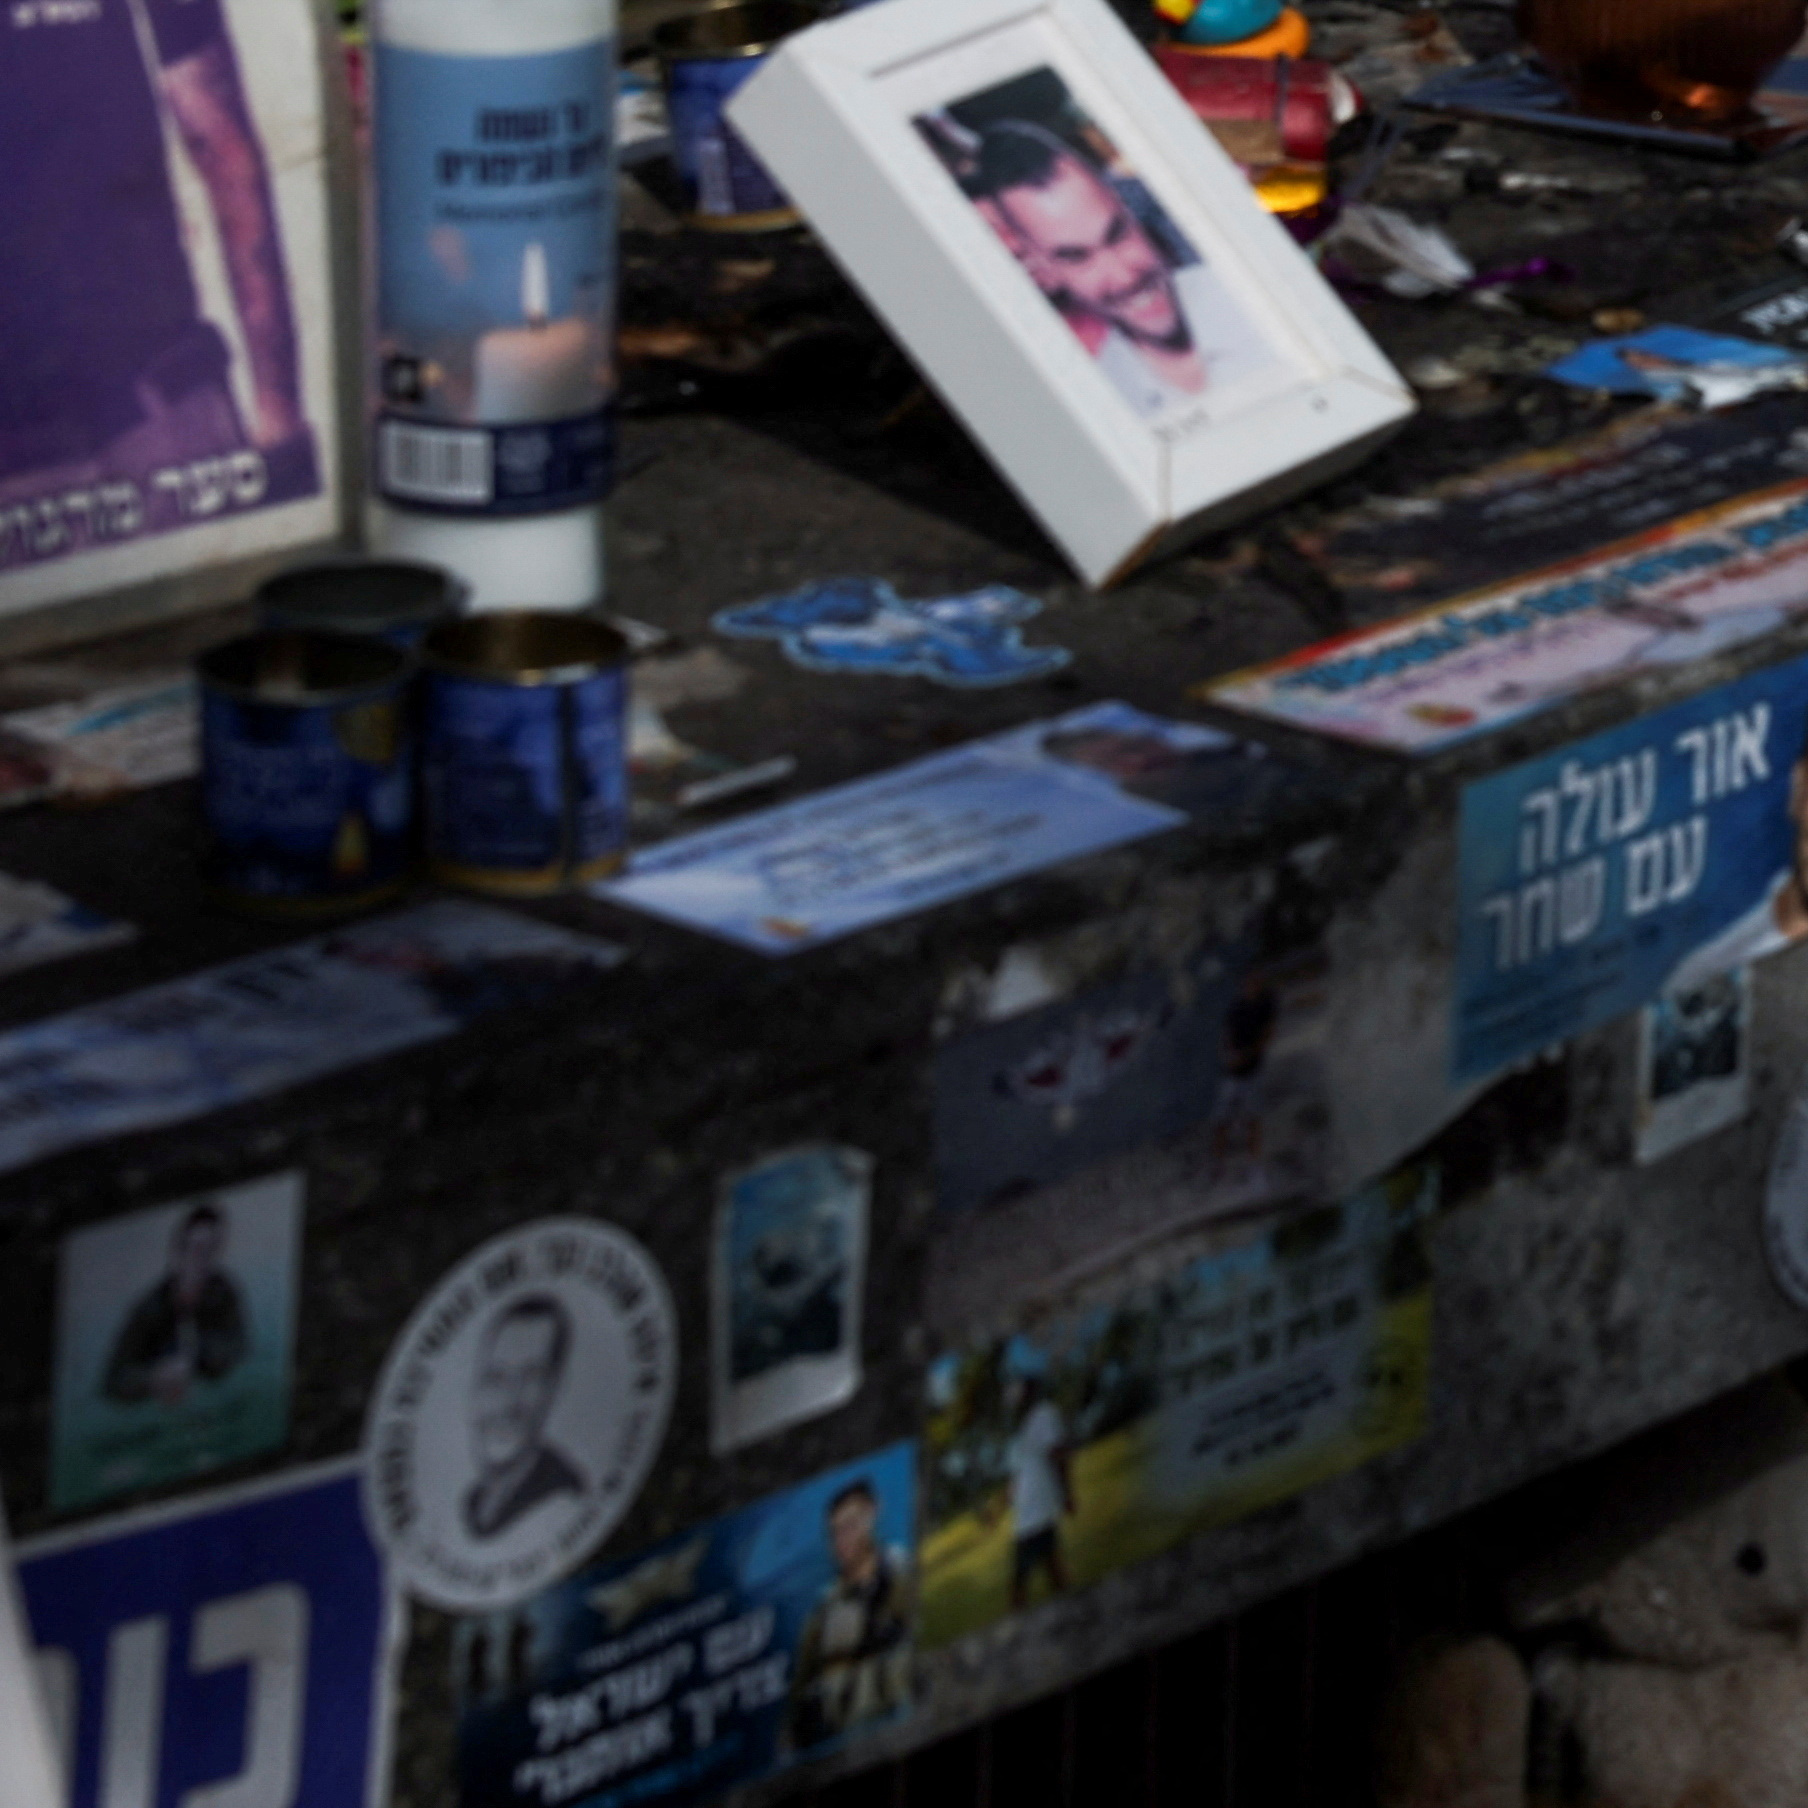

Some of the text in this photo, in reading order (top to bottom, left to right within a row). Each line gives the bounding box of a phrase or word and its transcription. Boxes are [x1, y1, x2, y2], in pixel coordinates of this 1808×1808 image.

[1518, 701, 1772, 873] אור עולה
[1480, 818, 1709, 971] עם שחר
[528, 1640, 695, 1754] ישראל
